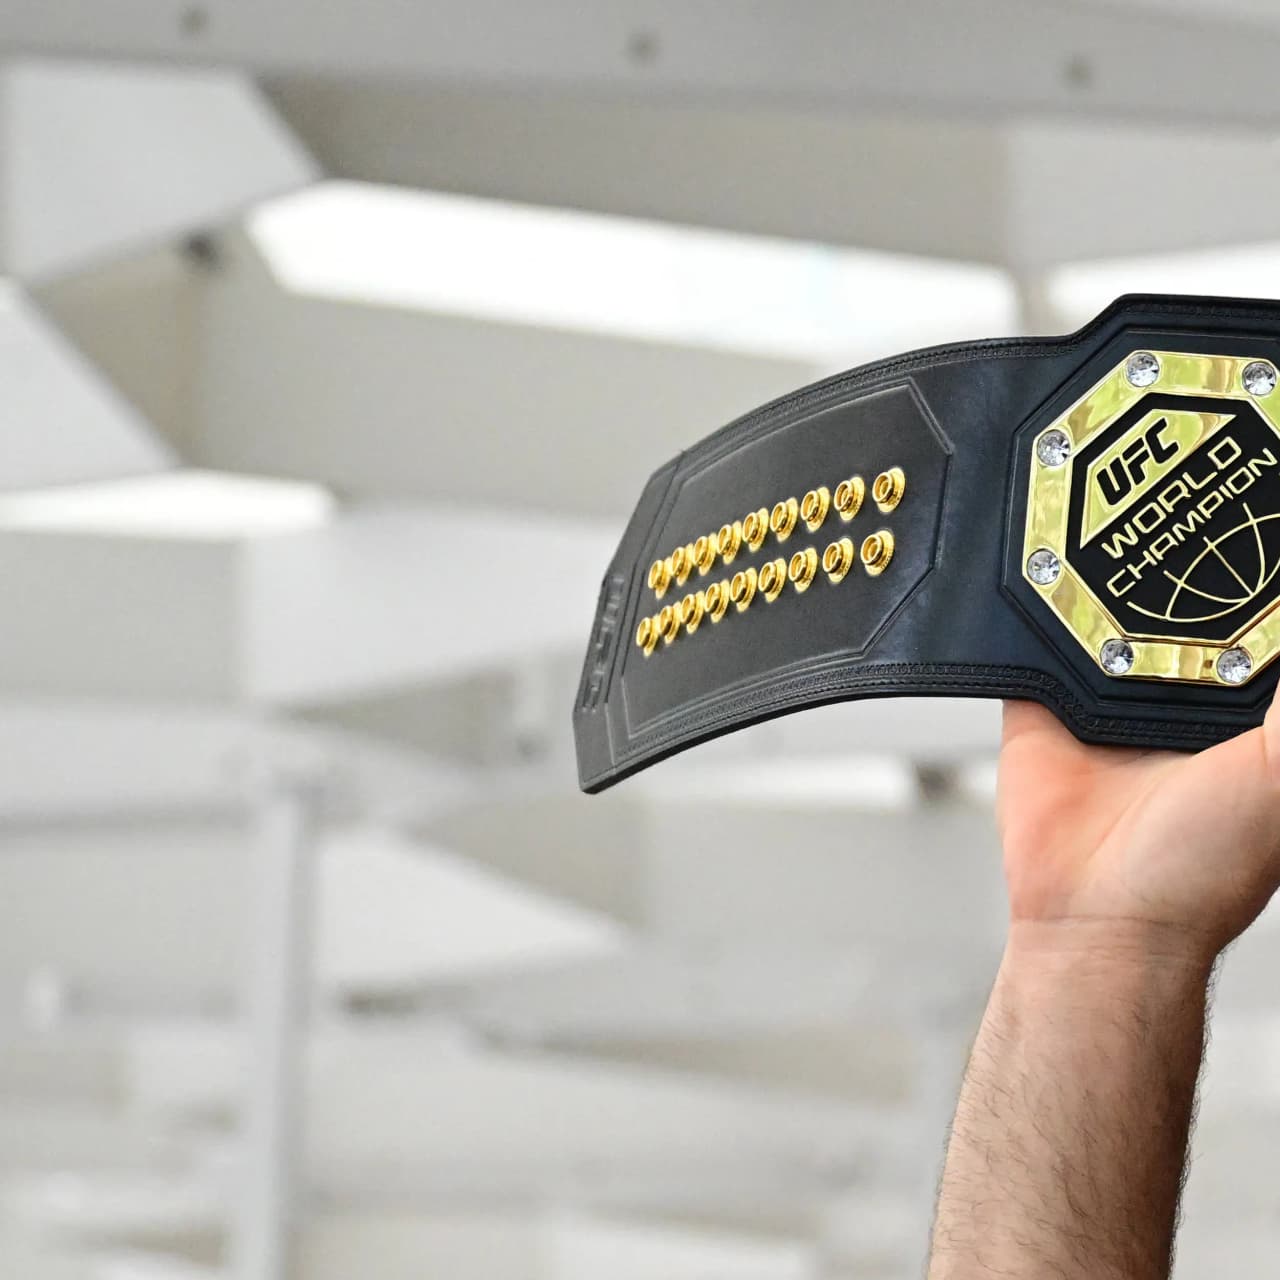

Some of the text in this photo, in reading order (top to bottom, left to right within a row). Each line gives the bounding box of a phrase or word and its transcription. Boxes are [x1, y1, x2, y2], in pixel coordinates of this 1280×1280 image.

[1096, 417, 1179, 505] UFC
[1101, 436, 1242, 560] WORLD
[1106, 447, 1279, 598] CHAMPION
